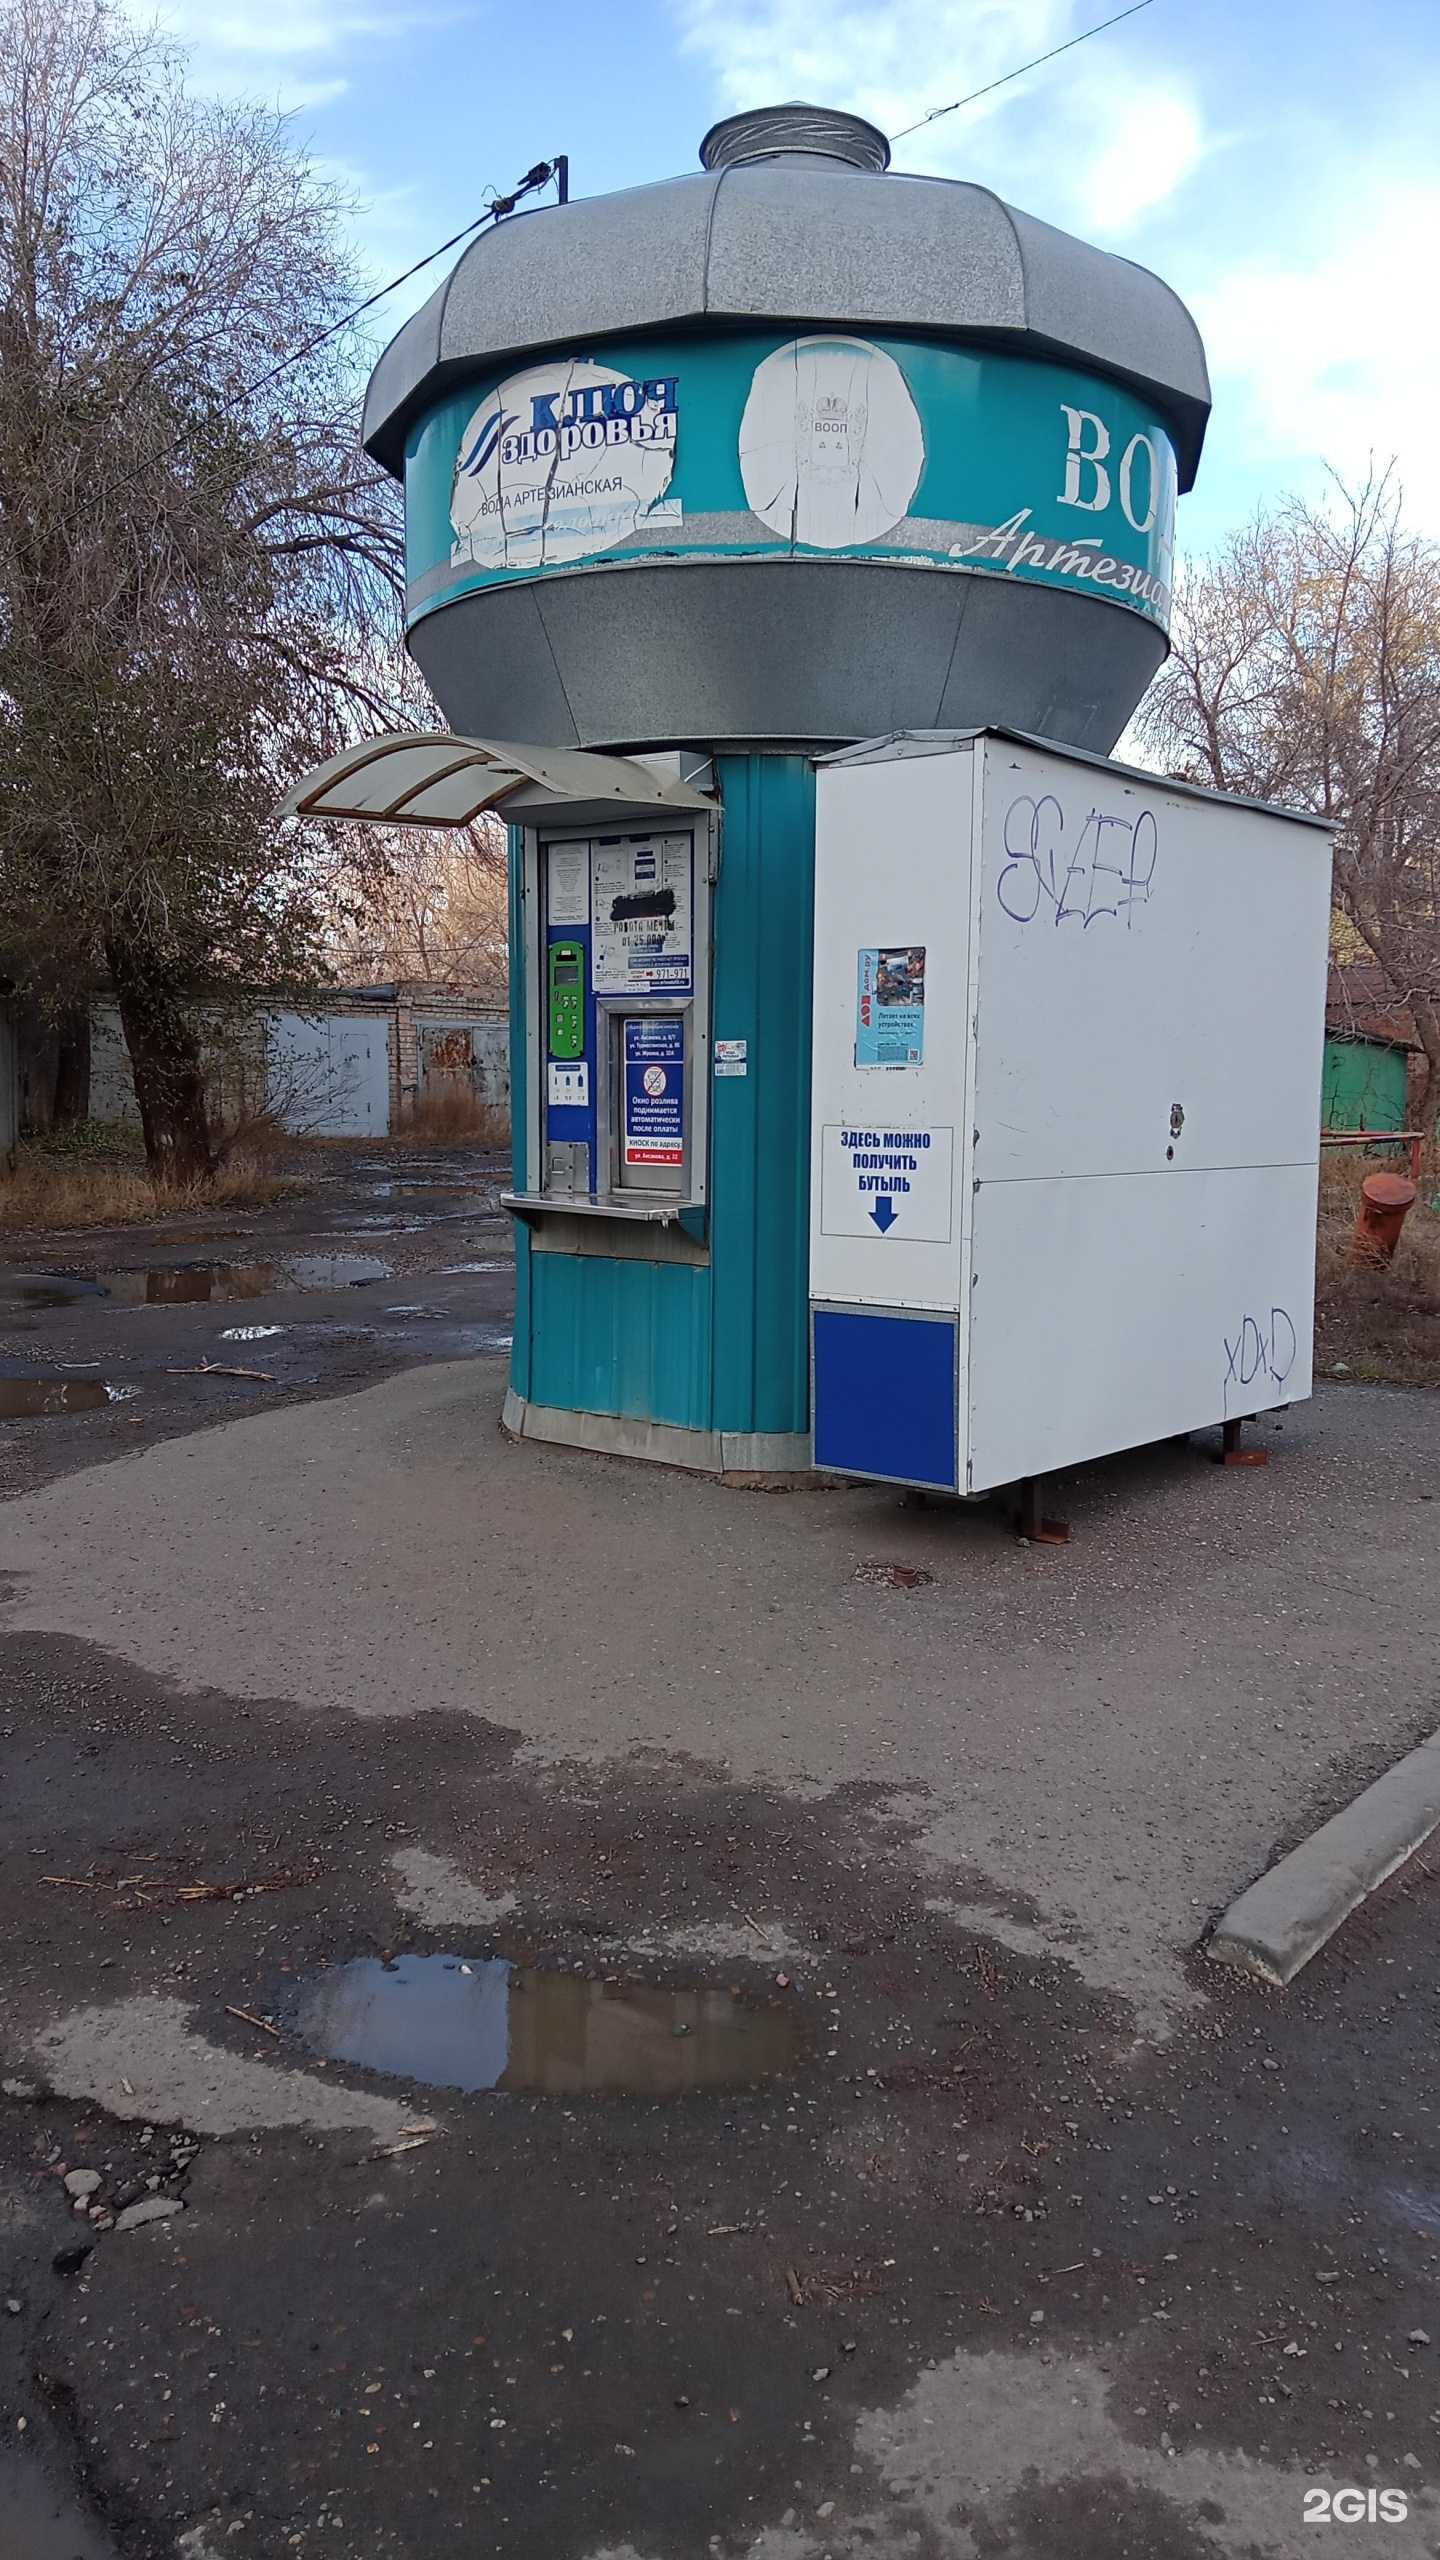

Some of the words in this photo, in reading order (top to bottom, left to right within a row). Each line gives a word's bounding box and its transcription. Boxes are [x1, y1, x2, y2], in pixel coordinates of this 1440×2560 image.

[815, 422, 848, 433] ВООП
[481, 497, 511, 516] ВОДА
[514, 476, 622, 509] АРТЕЗИАНСКАЯ
[656, 968, 688, 979] 971-971
[632, 1096, 650, 1105] Окно
[651, 1098, 678, 1106] розлива
[633, 1107, 678, 1115] поднимается
[629, 1139, 650, 1147] КИОСК
[841, 1131, 881, 1149] ЗДЕСЬ
[883, 1133, 931, 1149] МОЖНО
[853, 1153, 917, 1171] ПОЛУЧИТЬ
[859, 1175, 911, 1193] БУТЫЛЬ
